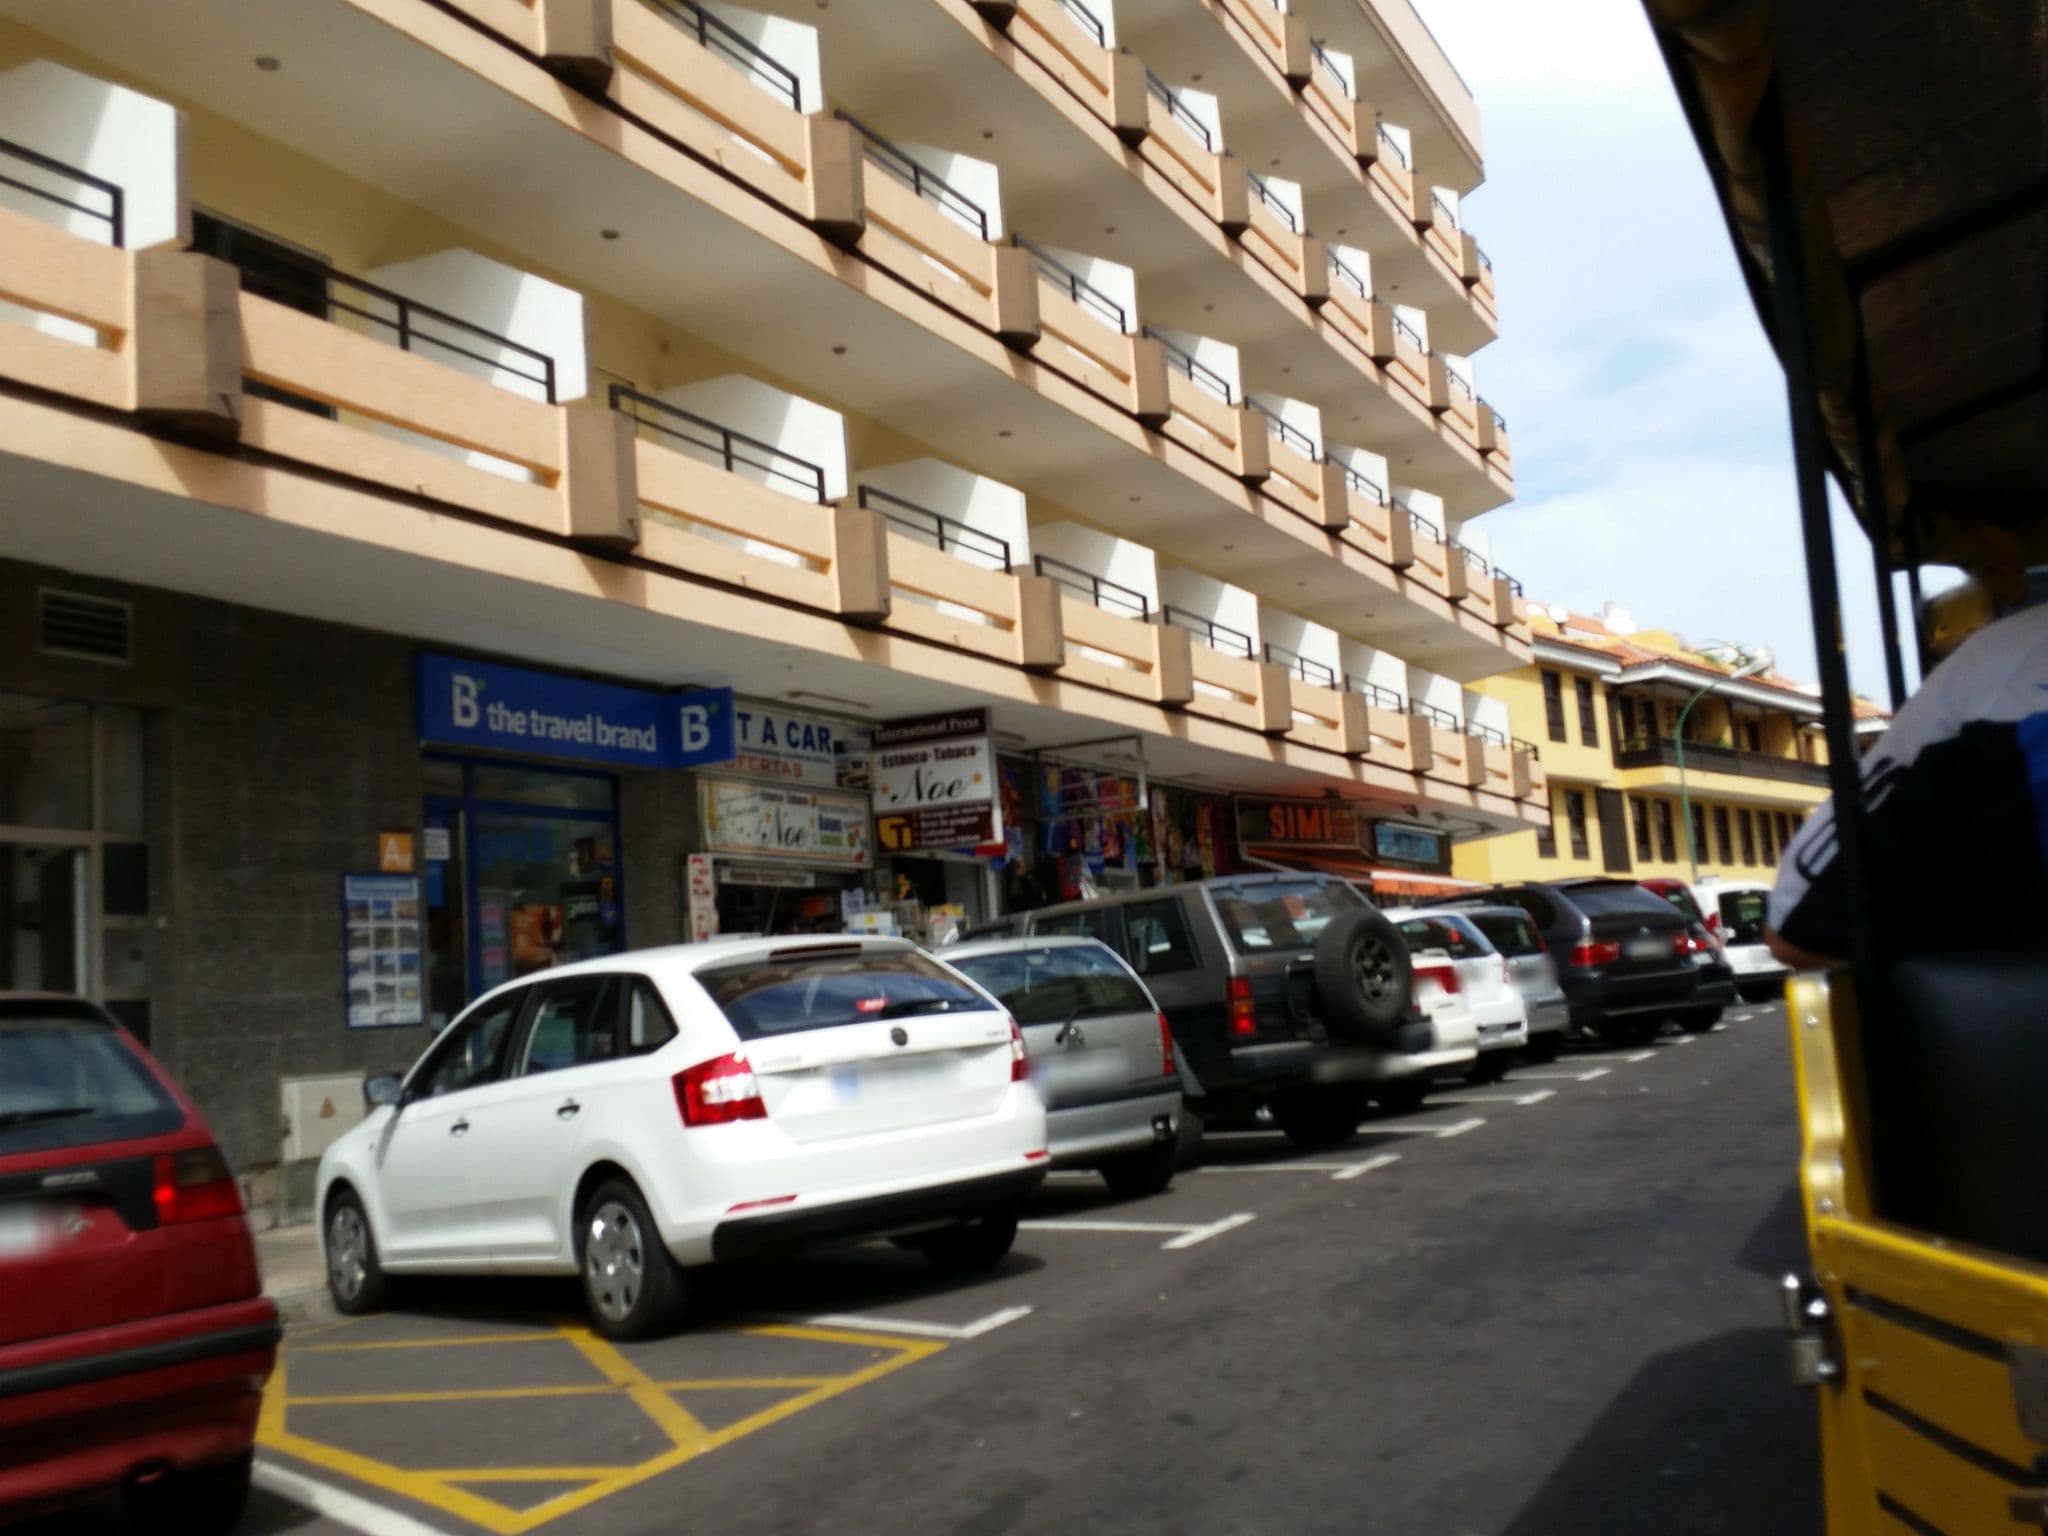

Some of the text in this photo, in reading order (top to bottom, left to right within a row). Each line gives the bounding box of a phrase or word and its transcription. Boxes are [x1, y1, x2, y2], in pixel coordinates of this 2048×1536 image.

[452, 674, 657, 752] B the travel brand
[680, 704, 710, 752] B
[762, 716, 777, 745] A
[786, 720, 832, 753] CAR
[891, 767, 966, 803] Noe
